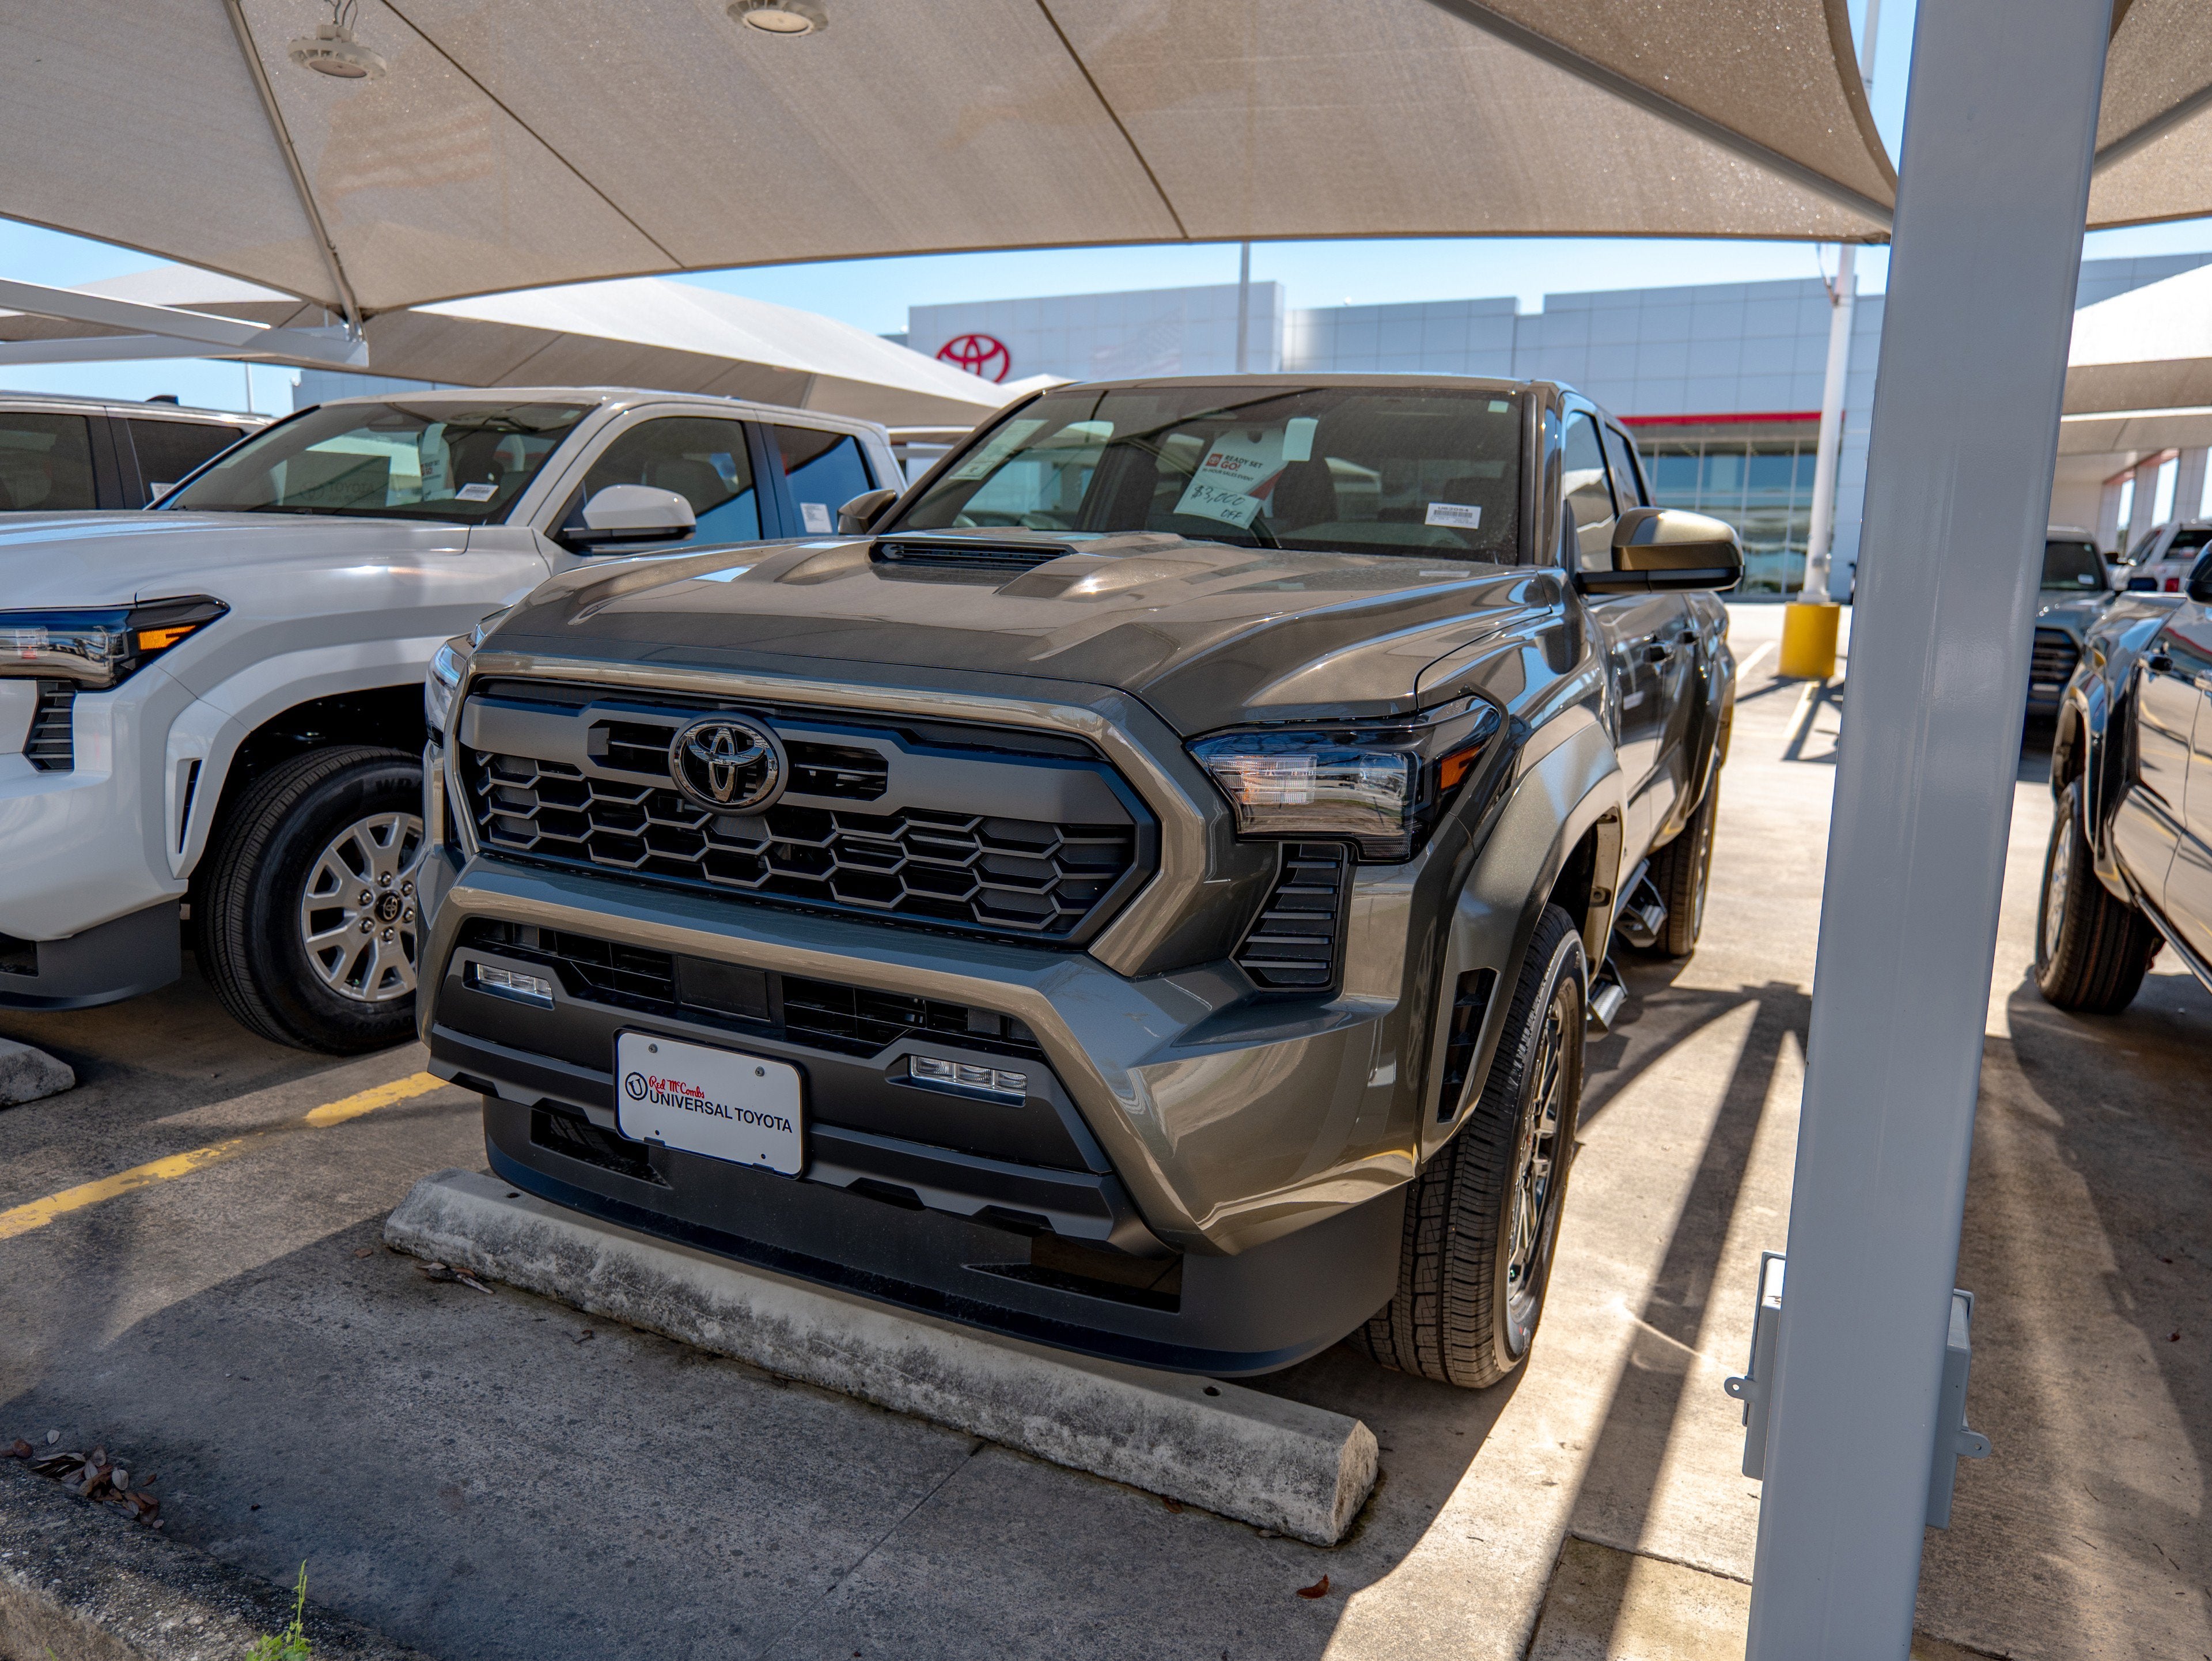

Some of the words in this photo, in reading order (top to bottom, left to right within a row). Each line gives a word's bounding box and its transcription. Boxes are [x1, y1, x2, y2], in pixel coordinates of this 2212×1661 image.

[1221, 461, 1242, 471] GO!
[1225, 455, 1248, 464] READY
[1191, 485, 1245, 506] $3,000
[1221, 509, 1243, 519] OFF
[628, 1079, 643, 1096] U
[649, 1075, 665, 1094] Red
[667, 1079, 704, 1099] McCombs
[650, 1090, 733, 1119] UNIVERSAL
[734, 1107, 793, 1133] TOYOTA
